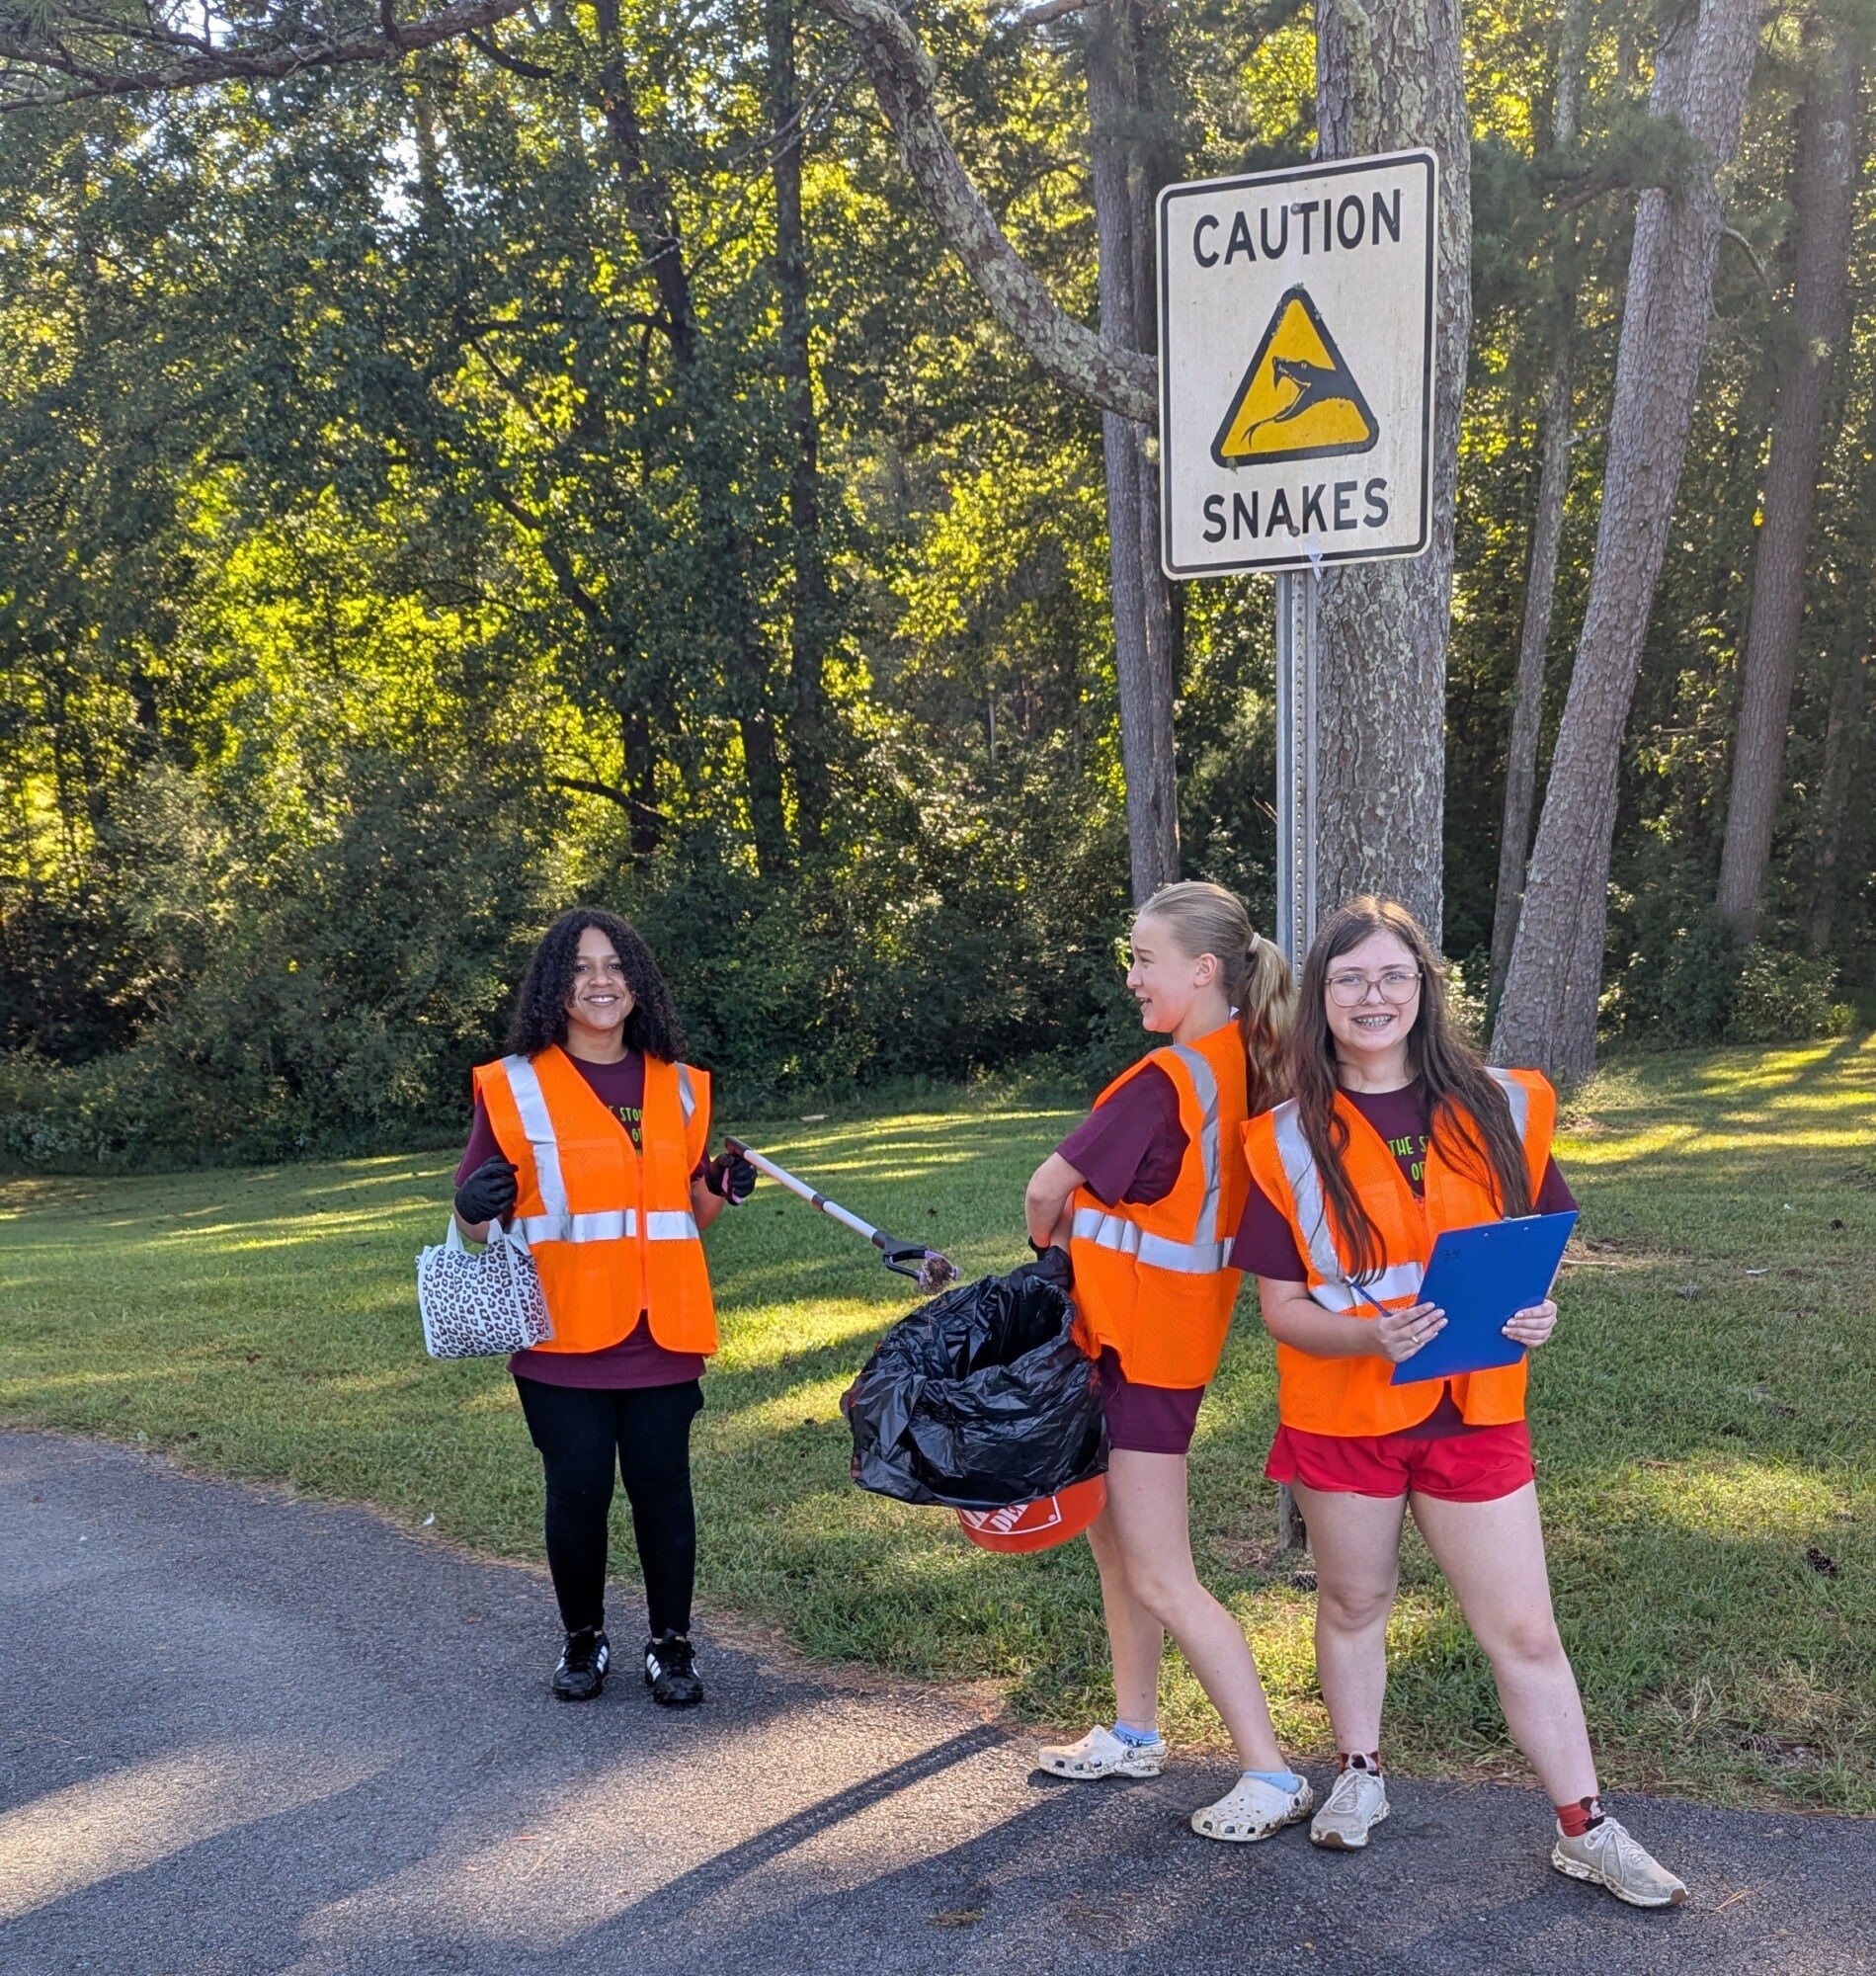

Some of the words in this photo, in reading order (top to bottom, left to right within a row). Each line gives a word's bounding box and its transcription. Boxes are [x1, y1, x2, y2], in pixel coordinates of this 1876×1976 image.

[1193, 189, 1402, 269] CAUTION
[1202, 478, 1389, 543] SNAKES
[1387, 1136, 1414, 1157] THE
